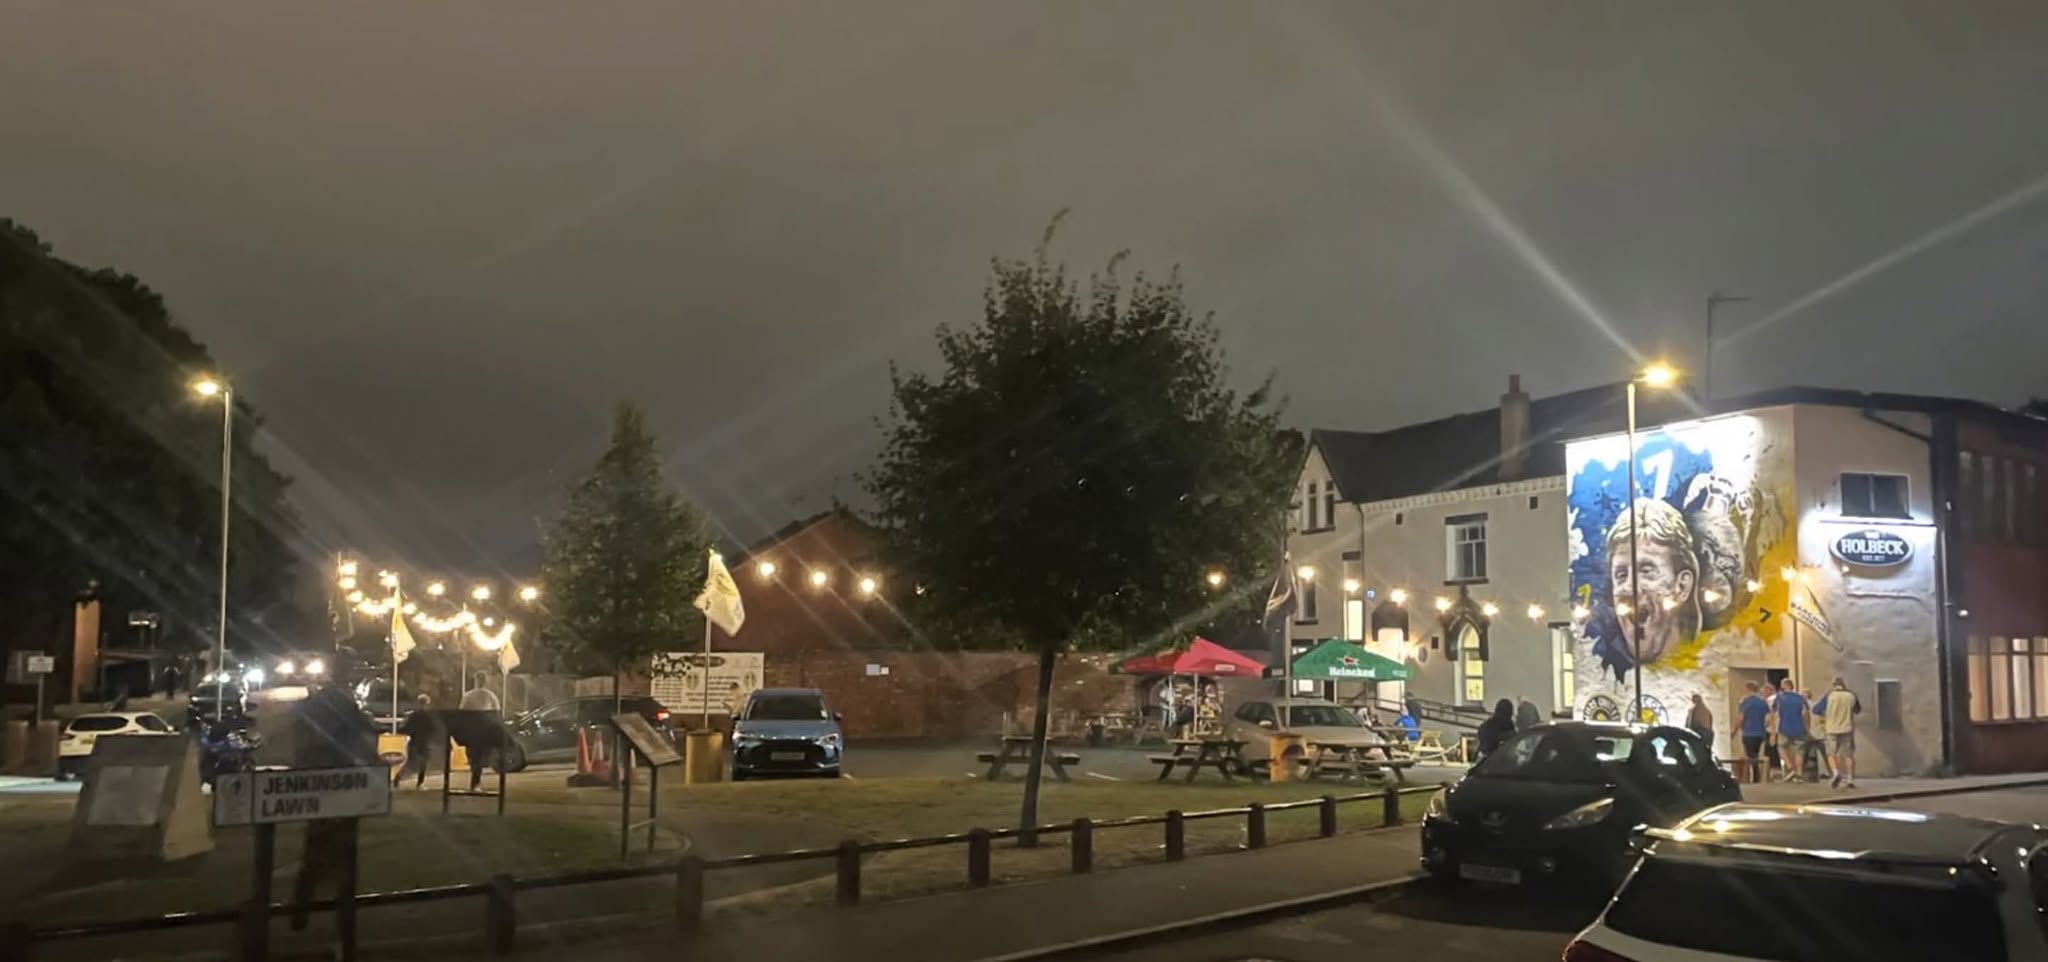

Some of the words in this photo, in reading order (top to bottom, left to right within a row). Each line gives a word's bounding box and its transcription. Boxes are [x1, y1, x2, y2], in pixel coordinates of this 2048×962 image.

[1642, 448, 1673, 500] 7
[1841, 539, 1904, 555] HOLBECK
[263, 772, 368, 795] JENKINSON
[261, 797, 320, 817] LAWN
